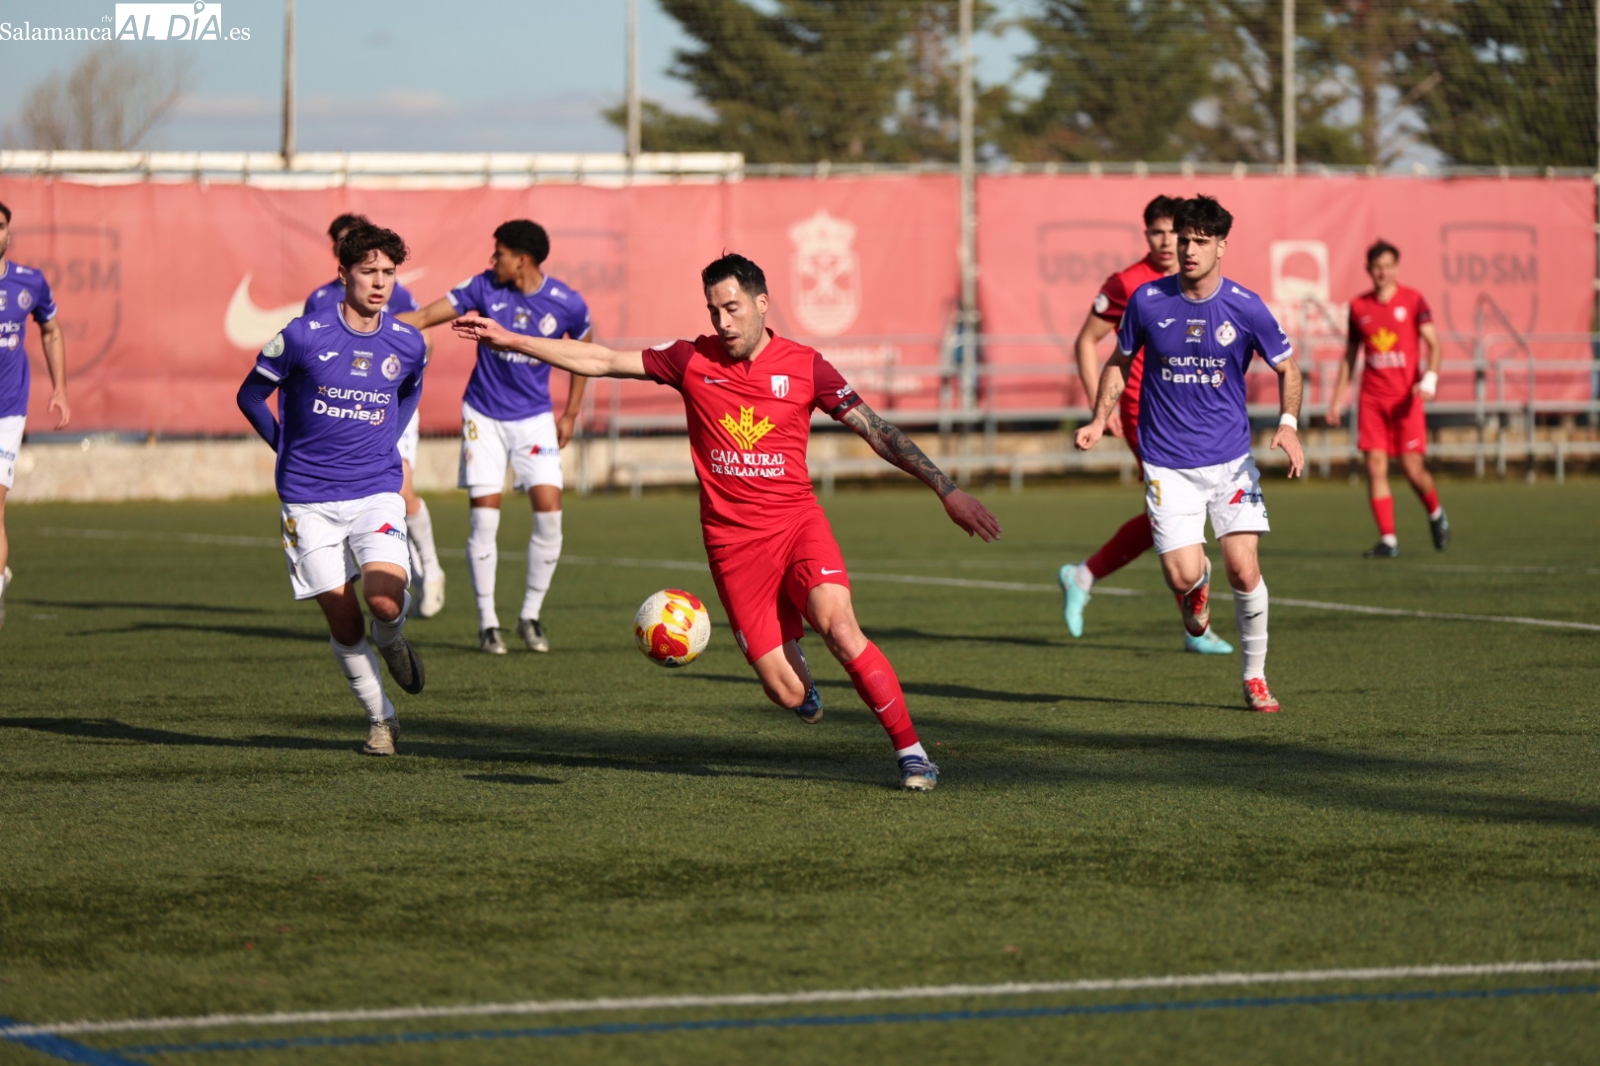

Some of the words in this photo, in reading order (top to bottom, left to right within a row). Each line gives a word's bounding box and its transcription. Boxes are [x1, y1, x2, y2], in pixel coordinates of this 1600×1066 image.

[1441, 253, 1538, 285] UDSM
[1168, 356, 1228, 368] euronics
[327, 386, 392, 405] euronics
[312, 398, 385, 425] Danisa
[710, 448, 740, 465] CAJA
[743, 453, 786, 466] RURAL
[711, 463, 723, 474] DE
[724, 466, 786, 478] SALAMANCA
